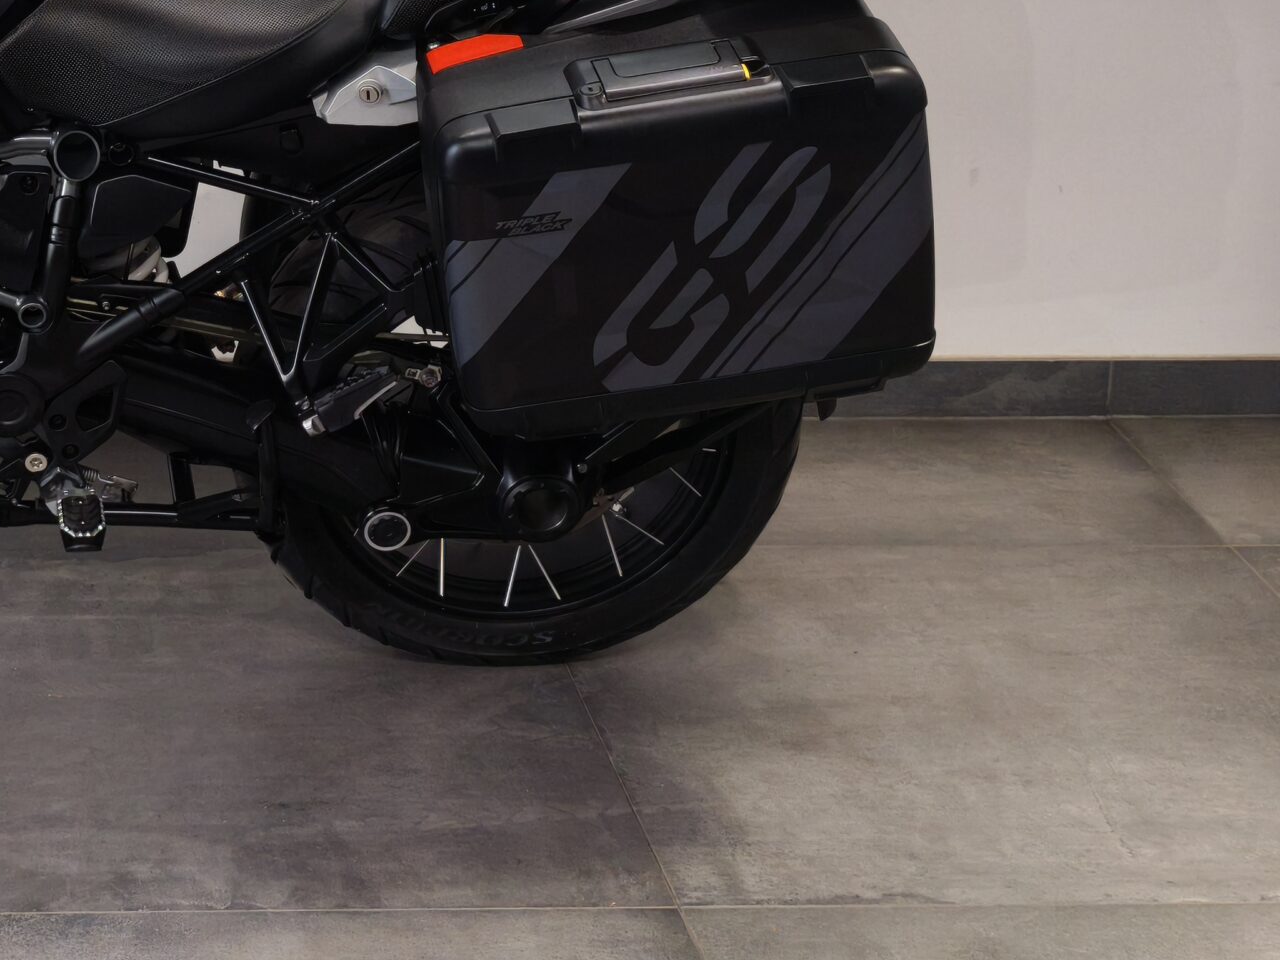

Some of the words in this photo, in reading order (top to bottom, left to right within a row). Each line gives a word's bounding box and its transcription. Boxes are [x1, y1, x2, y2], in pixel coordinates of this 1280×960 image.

[495, 213, 559, 230] TRIPLE
[507, 220, 565, 237] BLACK
[593, 141, 832, 393] GS
